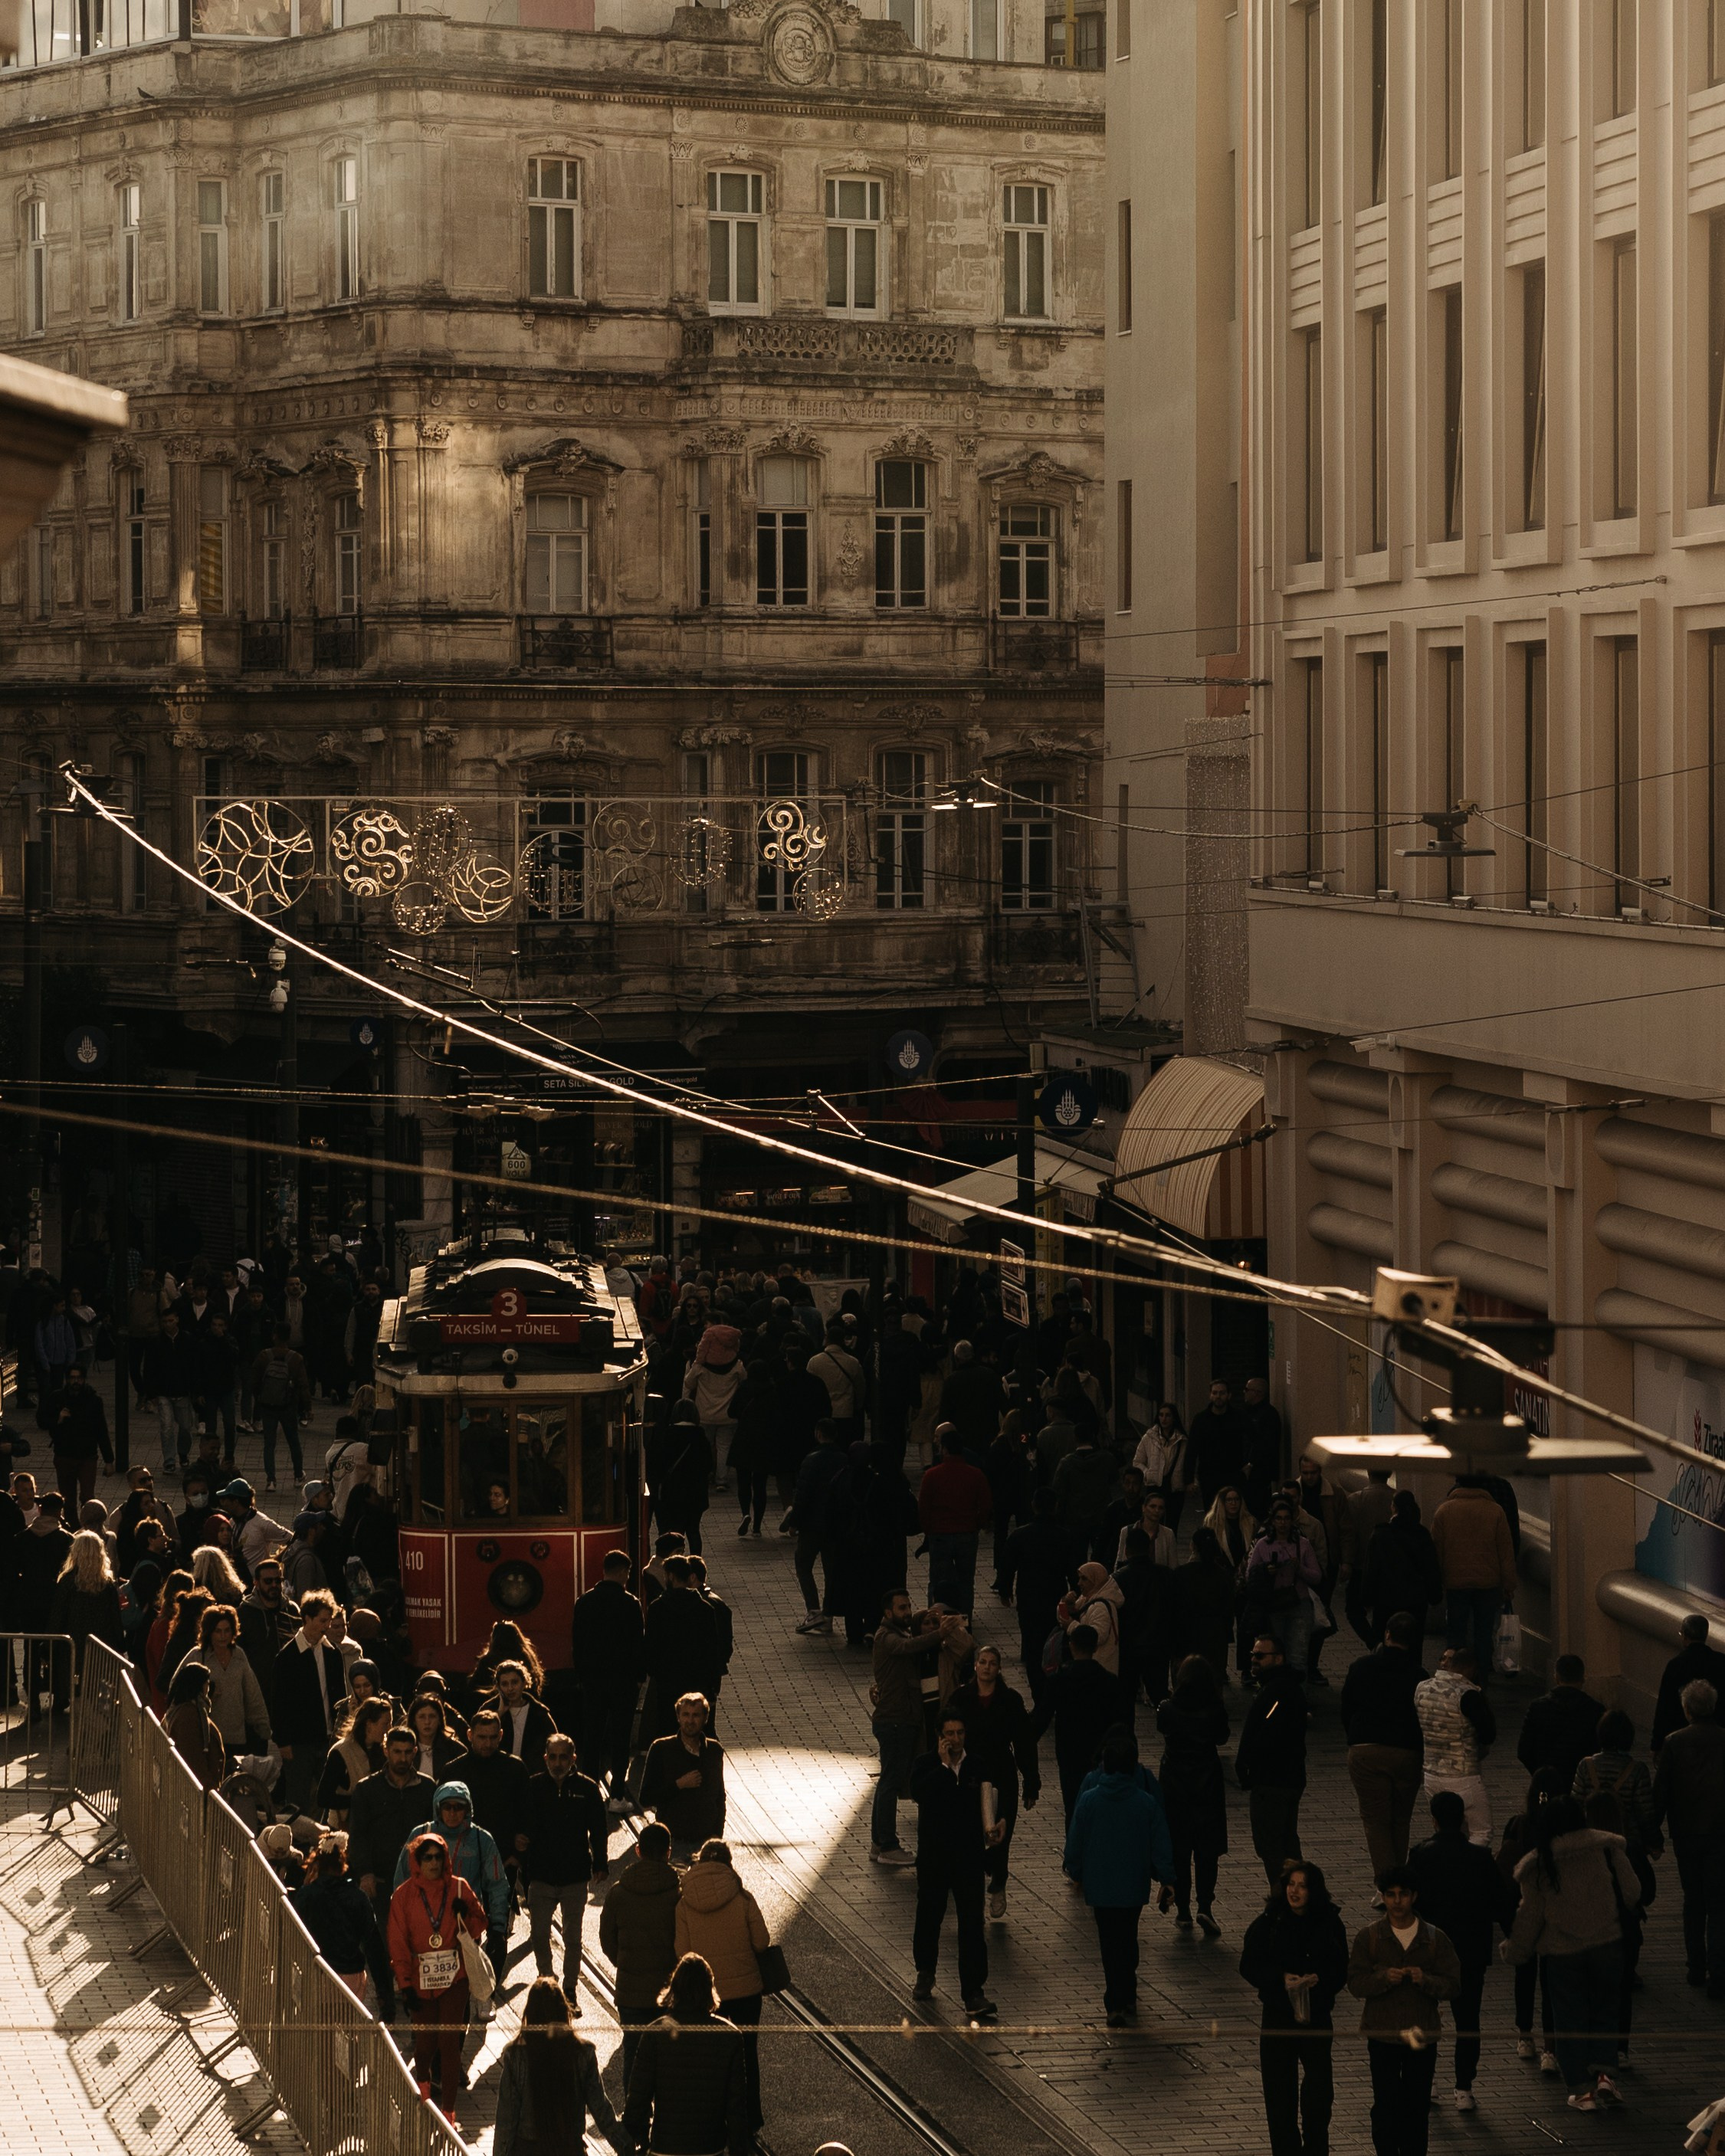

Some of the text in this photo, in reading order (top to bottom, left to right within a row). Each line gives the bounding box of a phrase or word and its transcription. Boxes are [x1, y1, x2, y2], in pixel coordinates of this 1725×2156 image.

[543, 1079, 566, 1089] SETA
[507, 1161, 526, 1169] 600
[500, 1292, 518, 1316] 3
[446, 1322, 497, 1335] TAKSİM
[515, 1322, 560, 1335] TÜNEL
[1704, 1423, 1725, 1462] Ziraa
[405, 1551, 424, 1571] 410
[422, 1597, 441, 1607] YASAK
[423, 1962, 457, 1974] D 3836
